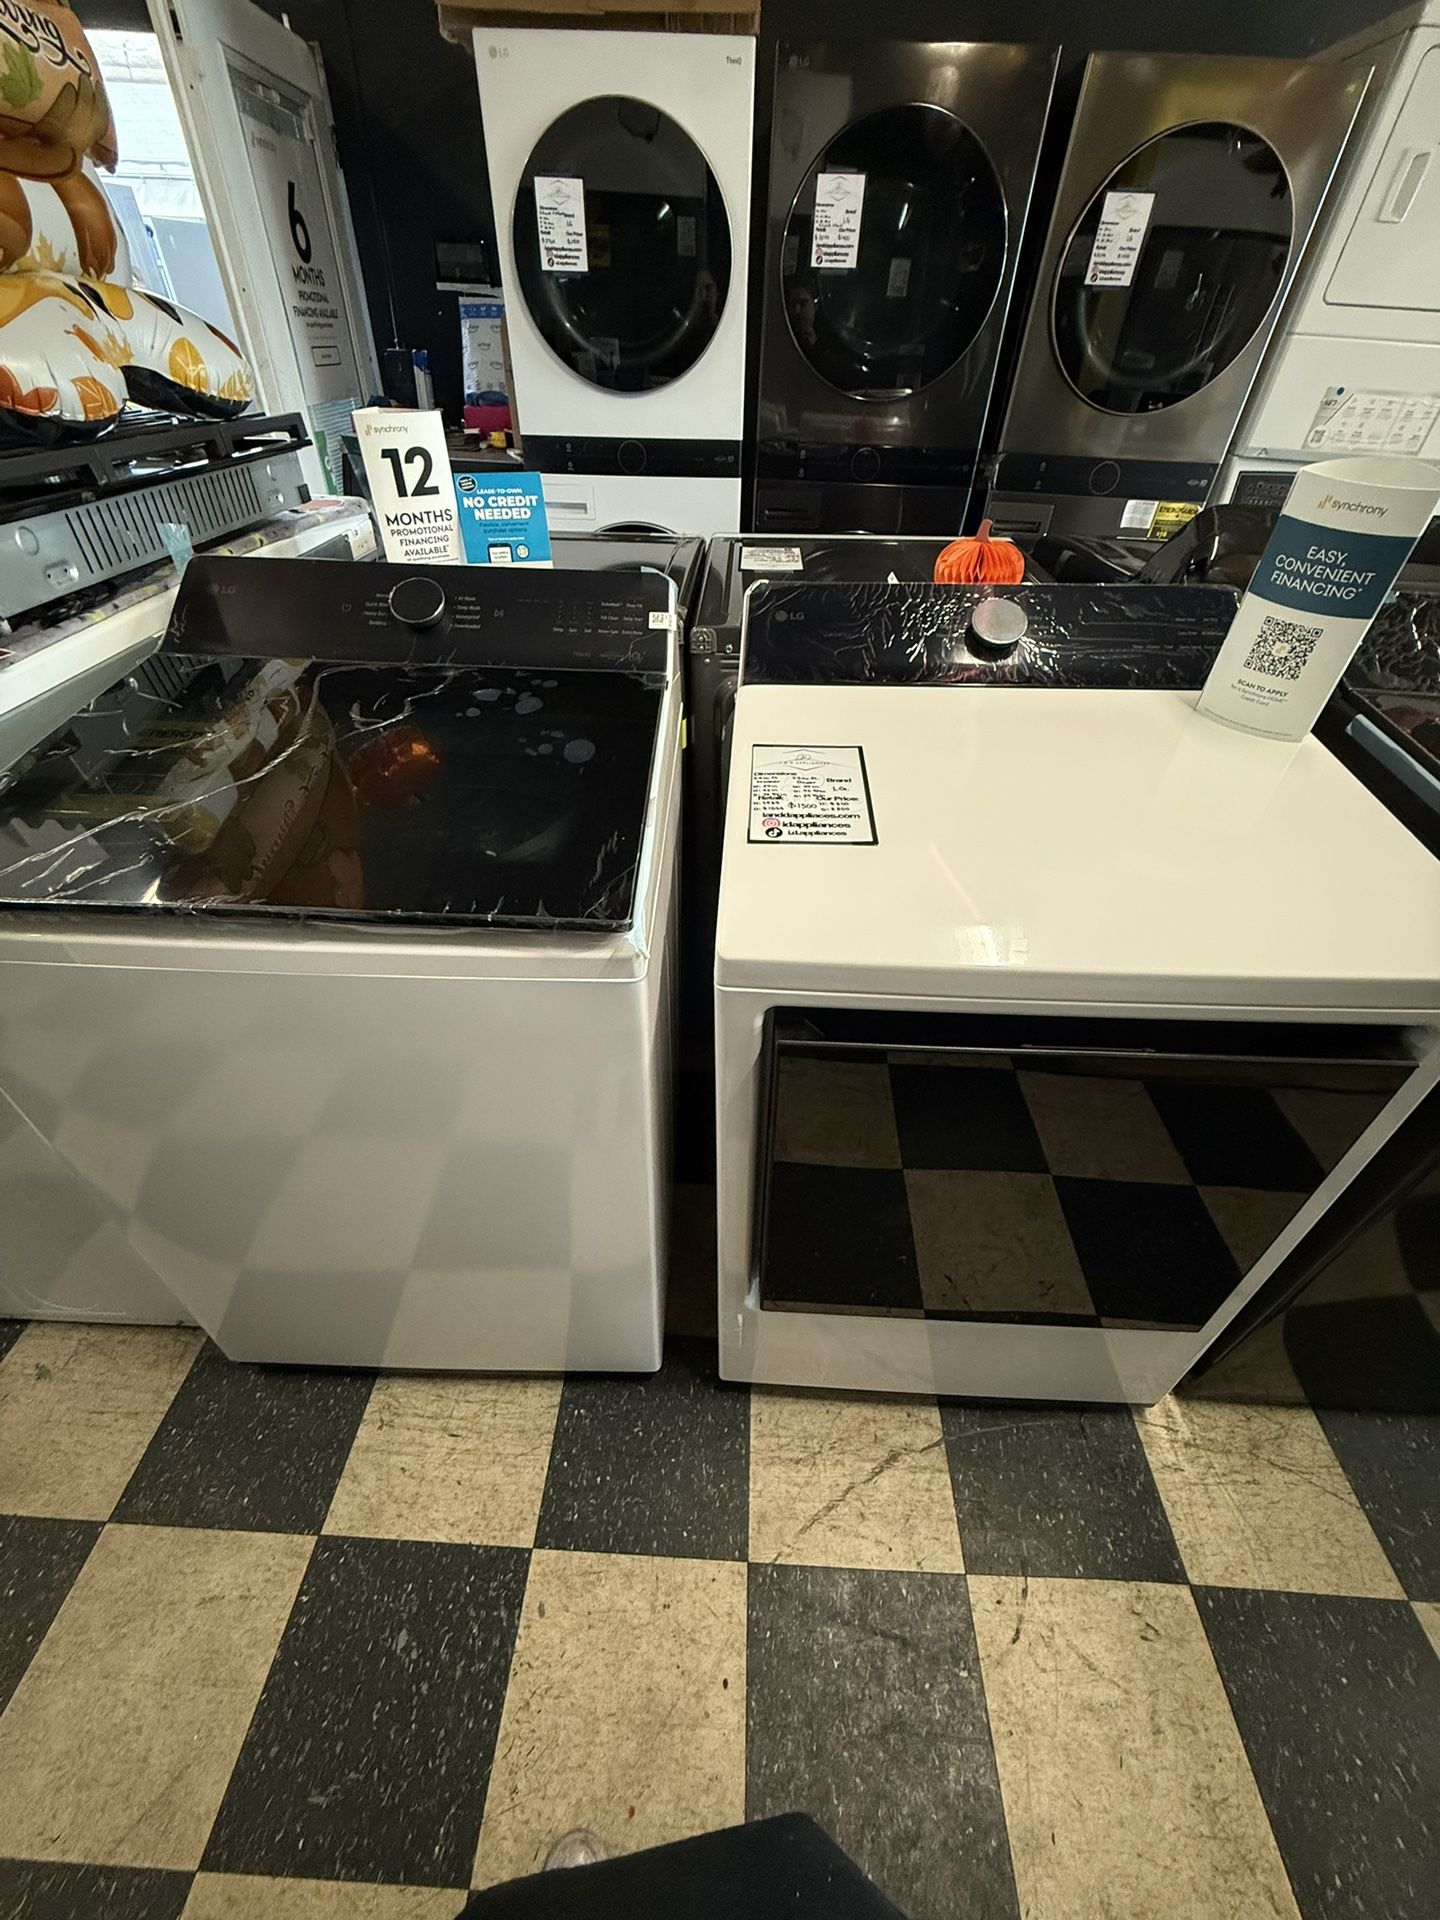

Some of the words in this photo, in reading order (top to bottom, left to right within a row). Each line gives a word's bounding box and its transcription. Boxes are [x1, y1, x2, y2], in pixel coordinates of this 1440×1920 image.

[288, 180, 312, 264] 6
[292, 265, 325, 287] MONTHS
[373, 424, 408, 435] synchrony
[381, 446, 440, 498] 12
[462, 496, 485, 509] NO
[487, 495, 539, 508] CREDIT
[1329, 498, 1389, 518] synchrony
[385, 508, 453, 527] MONTHS
[473, 507, 531, 520] NEEDED
[390, 524, 454, 537] PROMOTIONAL
[400, 535, 450, 547] FINANCING
[1306, 545, 1349, 568] EASY,
[1275, 554, 1377, 586] CONVENIENT
[790, 611, 805, 620] LG
[1237, 679, 1256, 689] SCAN
[1266, 689, 1288, 698] APPLY
